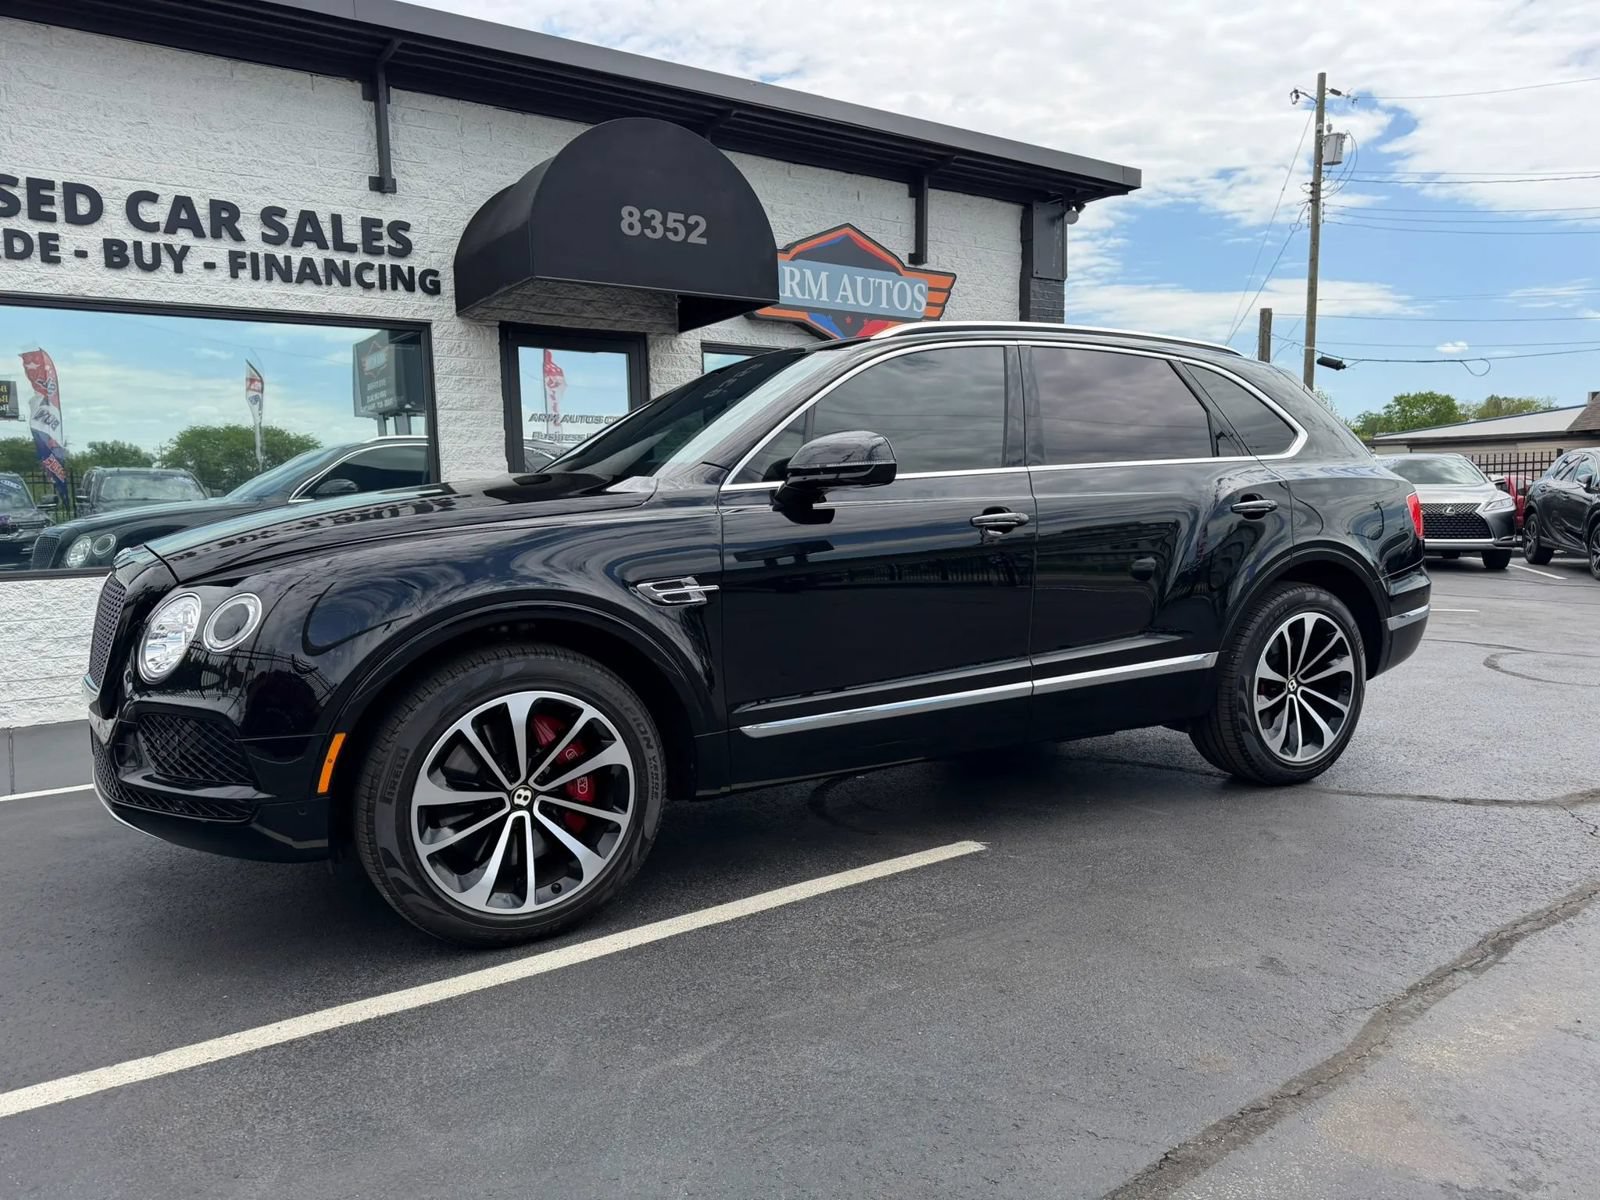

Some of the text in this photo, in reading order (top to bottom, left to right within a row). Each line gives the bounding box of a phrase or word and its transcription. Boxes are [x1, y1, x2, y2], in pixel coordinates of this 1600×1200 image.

[126, 191, 247, 243] CAR
[260, 206, 413, 259] SALES
[620, 205, 708, 245] 8352
[0, 228, 62, 264] DE
[103, 238, 190, 274] BUY
[229, 250, 441, 296] FINANCING
[780, 265, 928, 314] RM AUTOS
[528, 413, 560, 423] ARM
